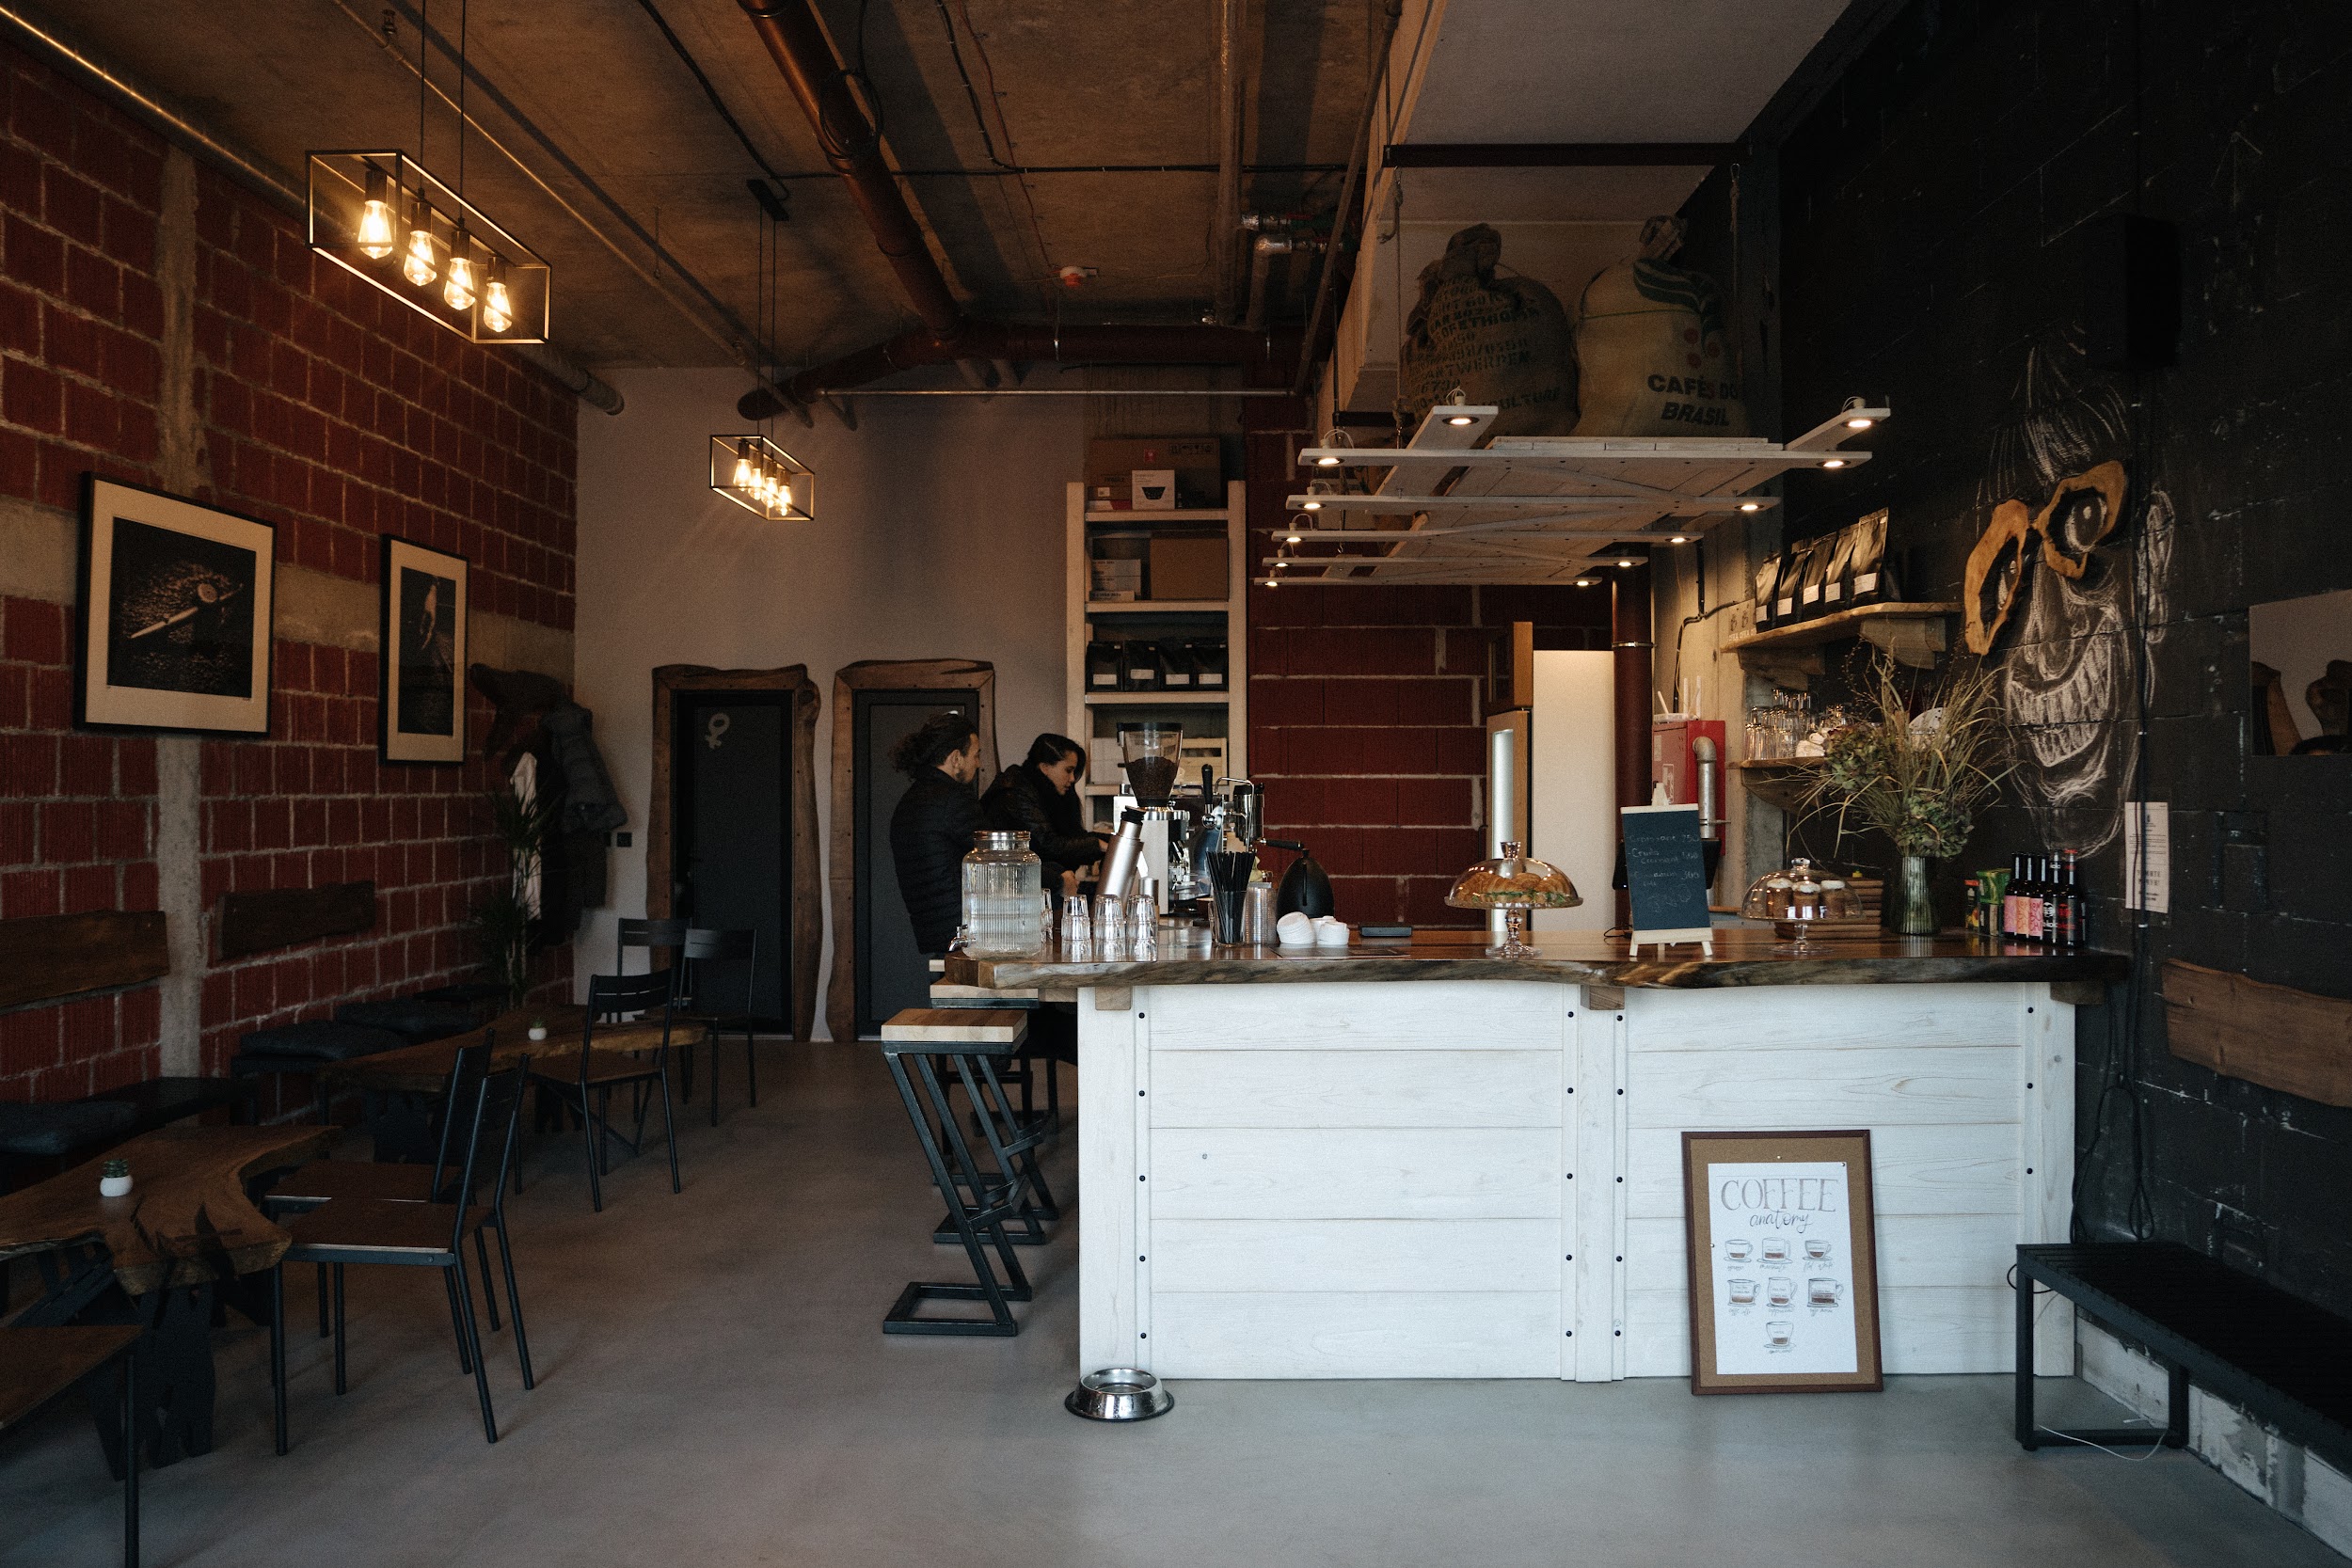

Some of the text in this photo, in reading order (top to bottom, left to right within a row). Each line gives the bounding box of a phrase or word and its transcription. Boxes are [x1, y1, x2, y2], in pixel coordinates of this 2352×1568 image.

[1661, 402, 1730, 426] BRASIL
[1721, 1178, 1838, 1212] COFFEE
[1749, 1209, 1813, 1234] anatomy
